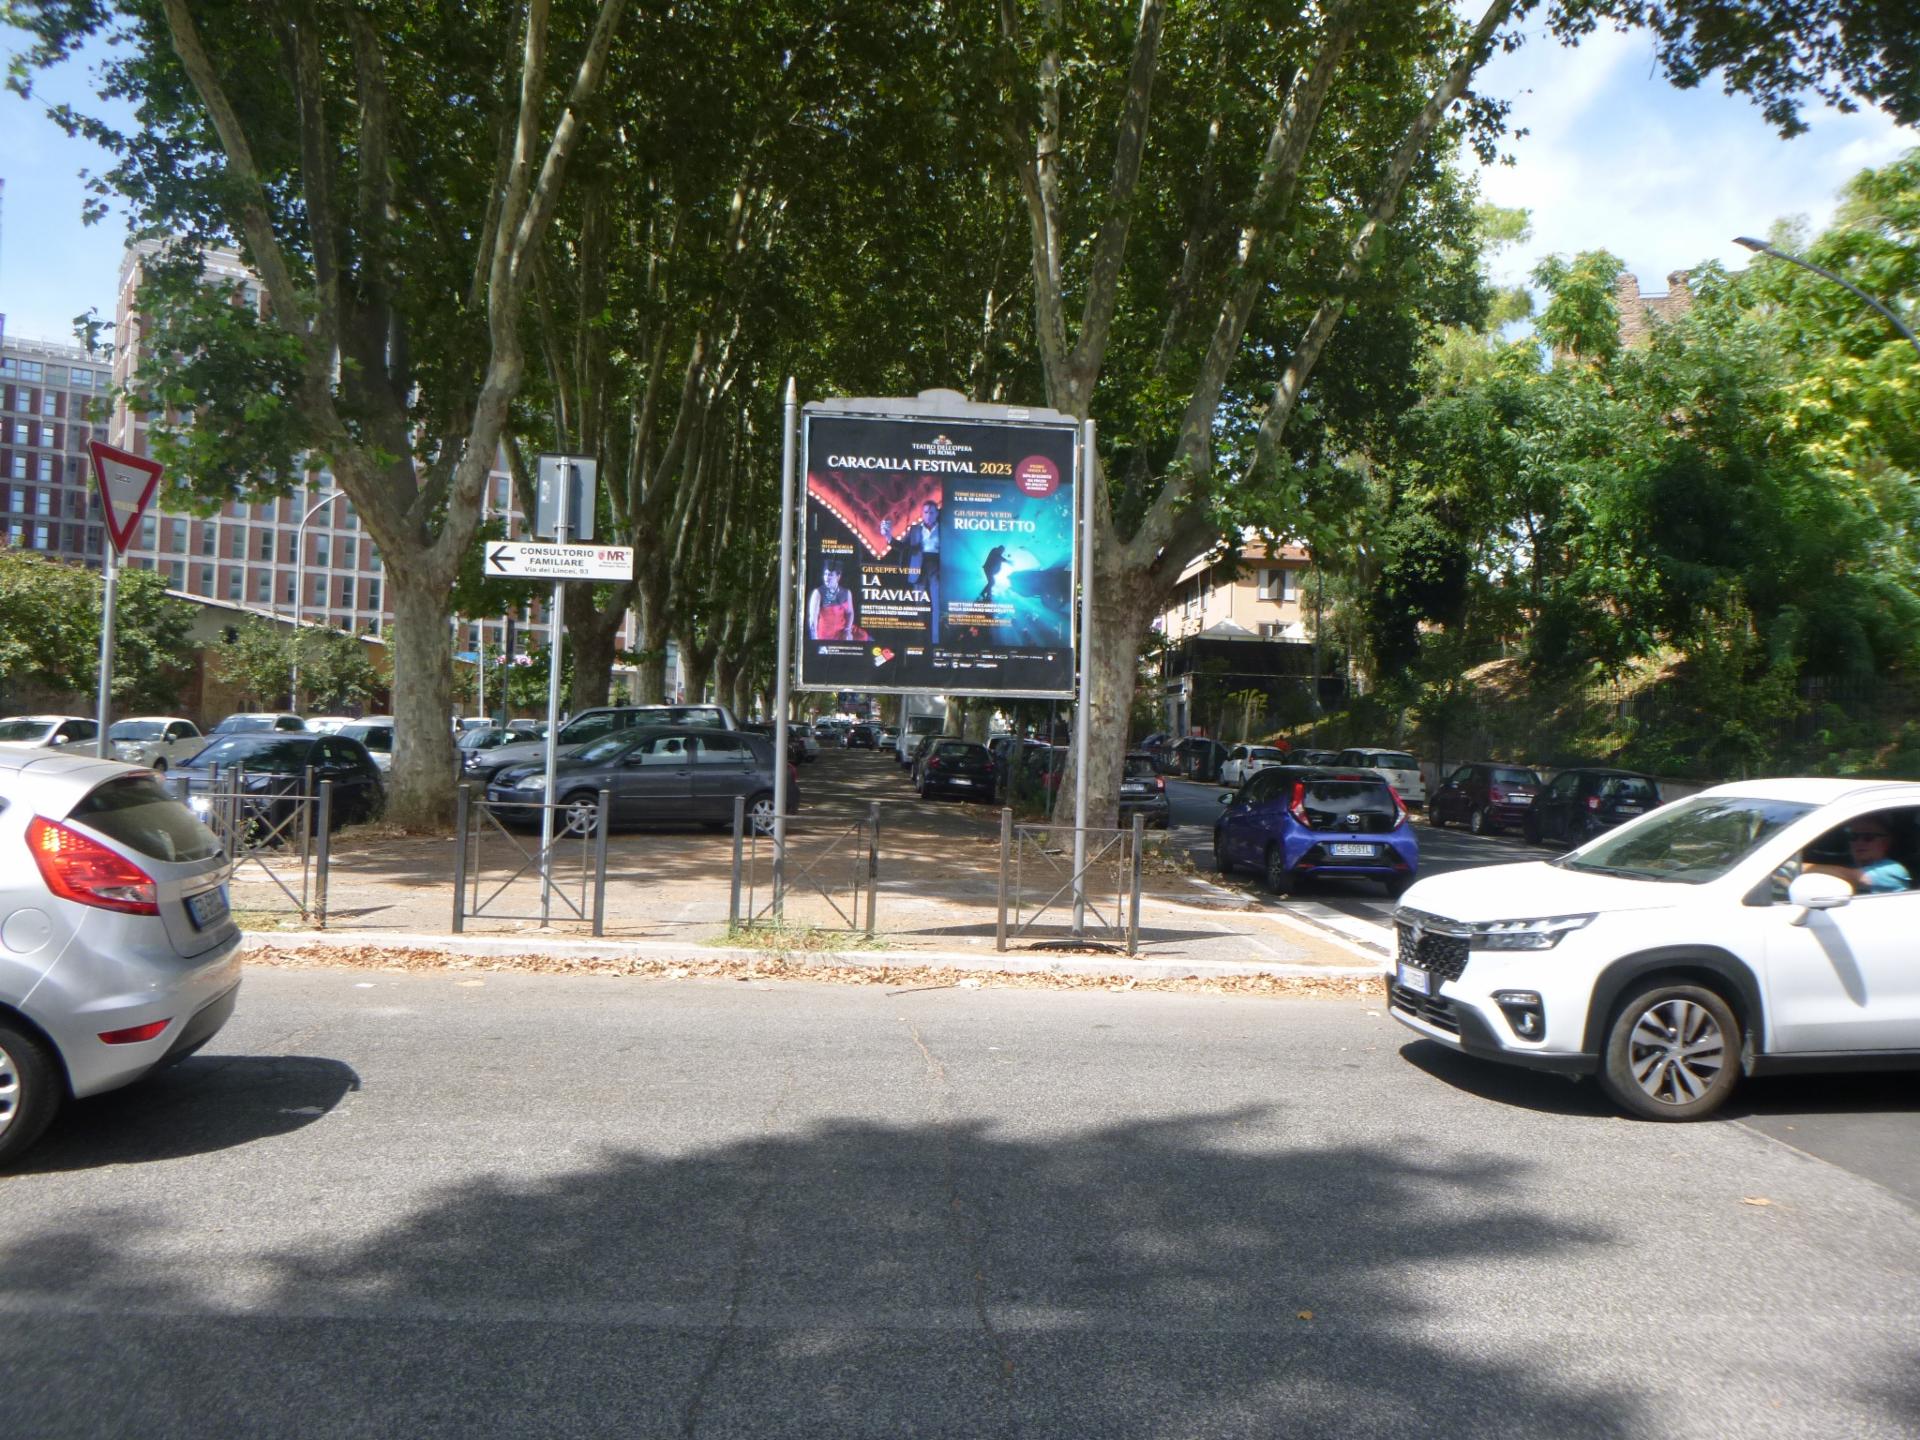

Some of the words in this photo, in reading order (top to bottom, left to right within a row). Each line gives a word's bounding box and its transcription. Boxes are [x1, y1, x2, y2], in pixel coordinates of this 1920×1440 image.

[827, 455, 911, 470] CARACALLA
[914, 459, 977, 473] FESTIVAL
[979, 462, 1012, 475] 2023
[954, 518, 1035, 532] RIGOLETTO
[520, 547, 594, 557] CONSULTORIO
[607, 550, 625, 561] MR
[529, 557, 585, 567] FAMILIARE
[899, 567, 921, 575] VERDI
[862, 574, 881, 586] LA
[861, 588, 931, 602] TRAVIATA
